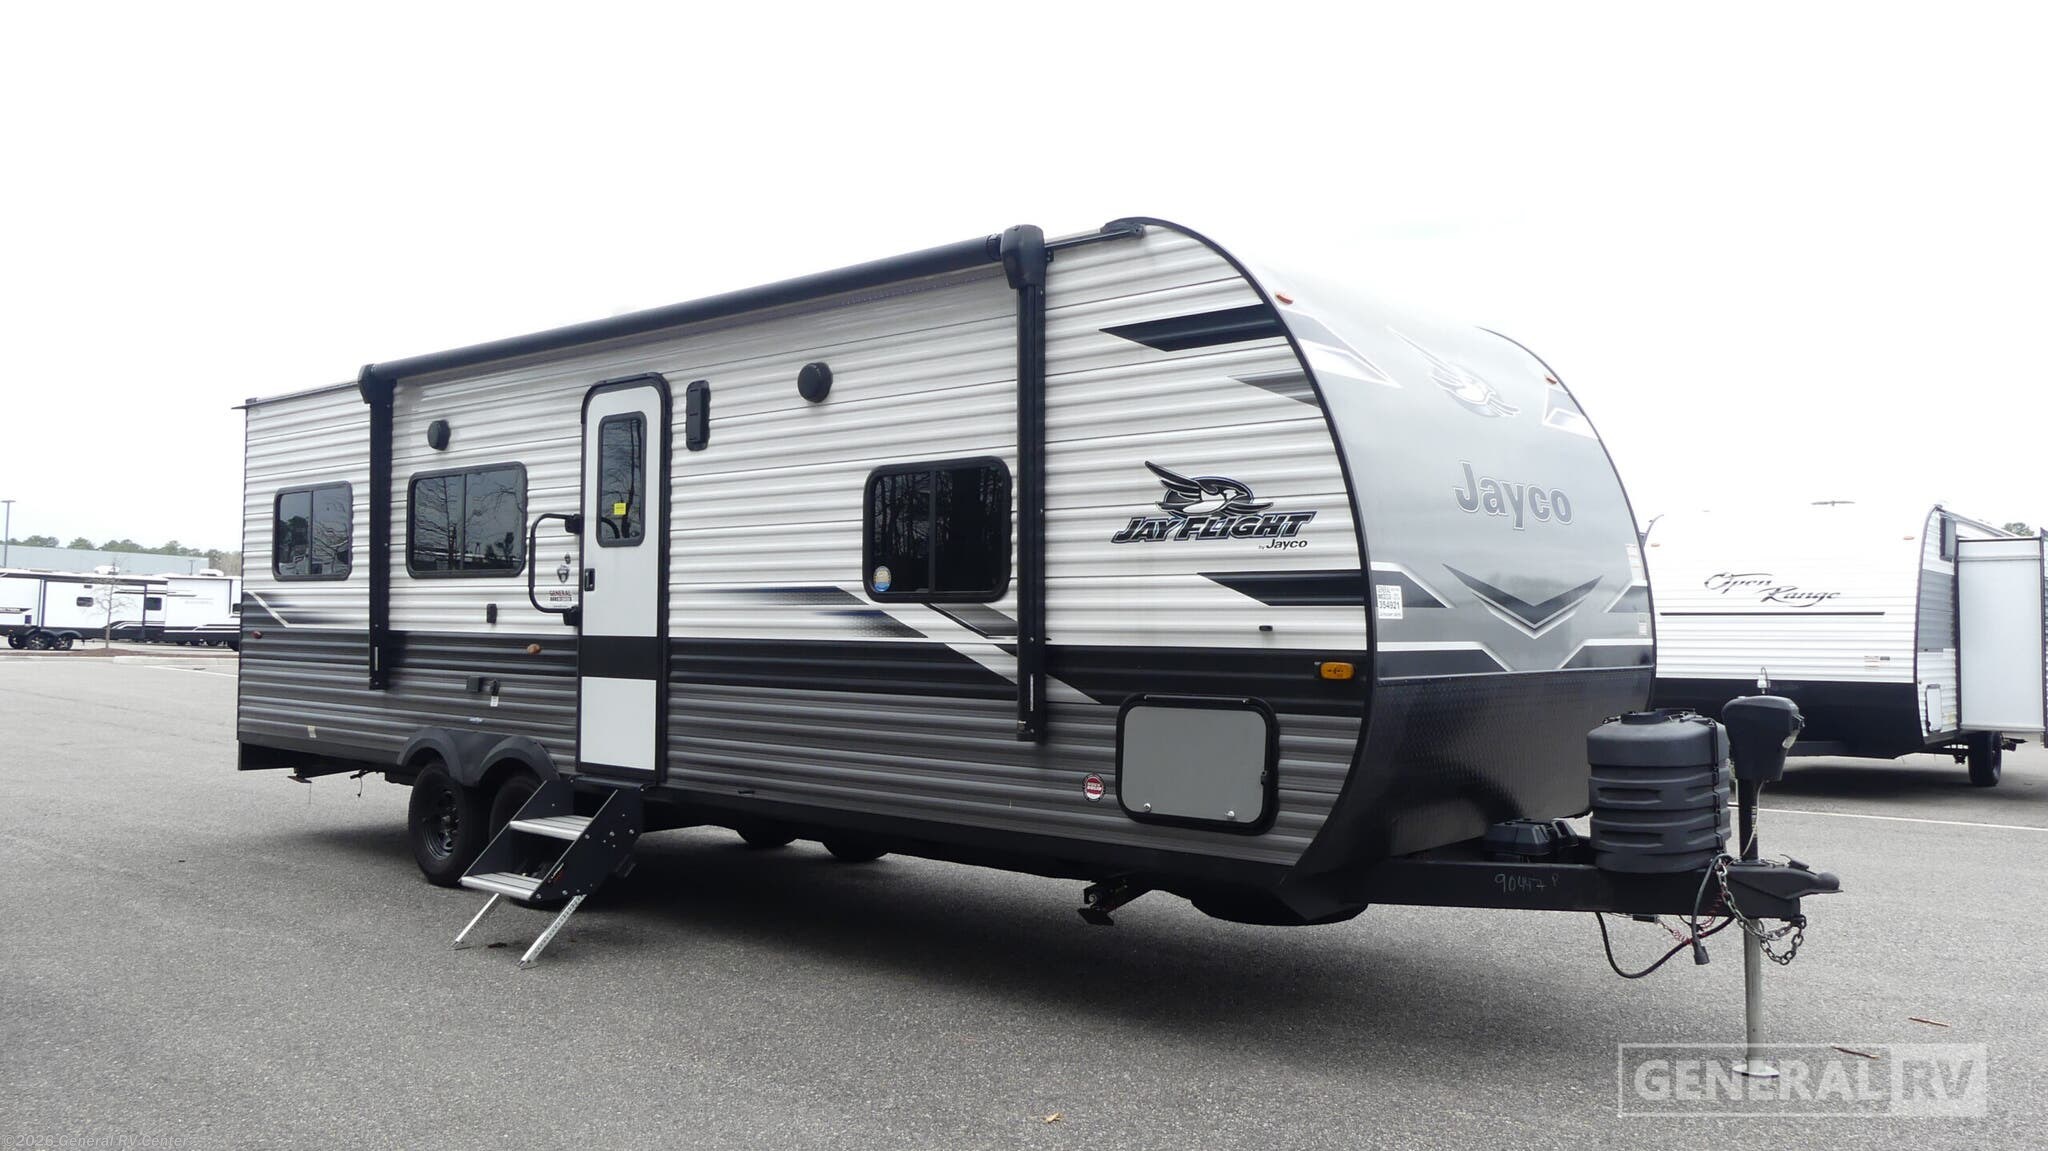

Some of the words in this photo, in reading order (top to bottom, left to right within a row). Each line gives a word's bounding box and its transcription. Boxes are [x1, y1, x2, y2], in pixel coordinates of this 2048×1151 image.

[1453, 459, 1575, 531] Jayco
[1111, 516, 1180, 544] JAY
[1173, 511, 1317, 541] FLIGHT
[1266, 538, 1308, 551] Jayco
[1704, 572, 1773, 594] Open
[1756, 586, 1841, 608] Range
